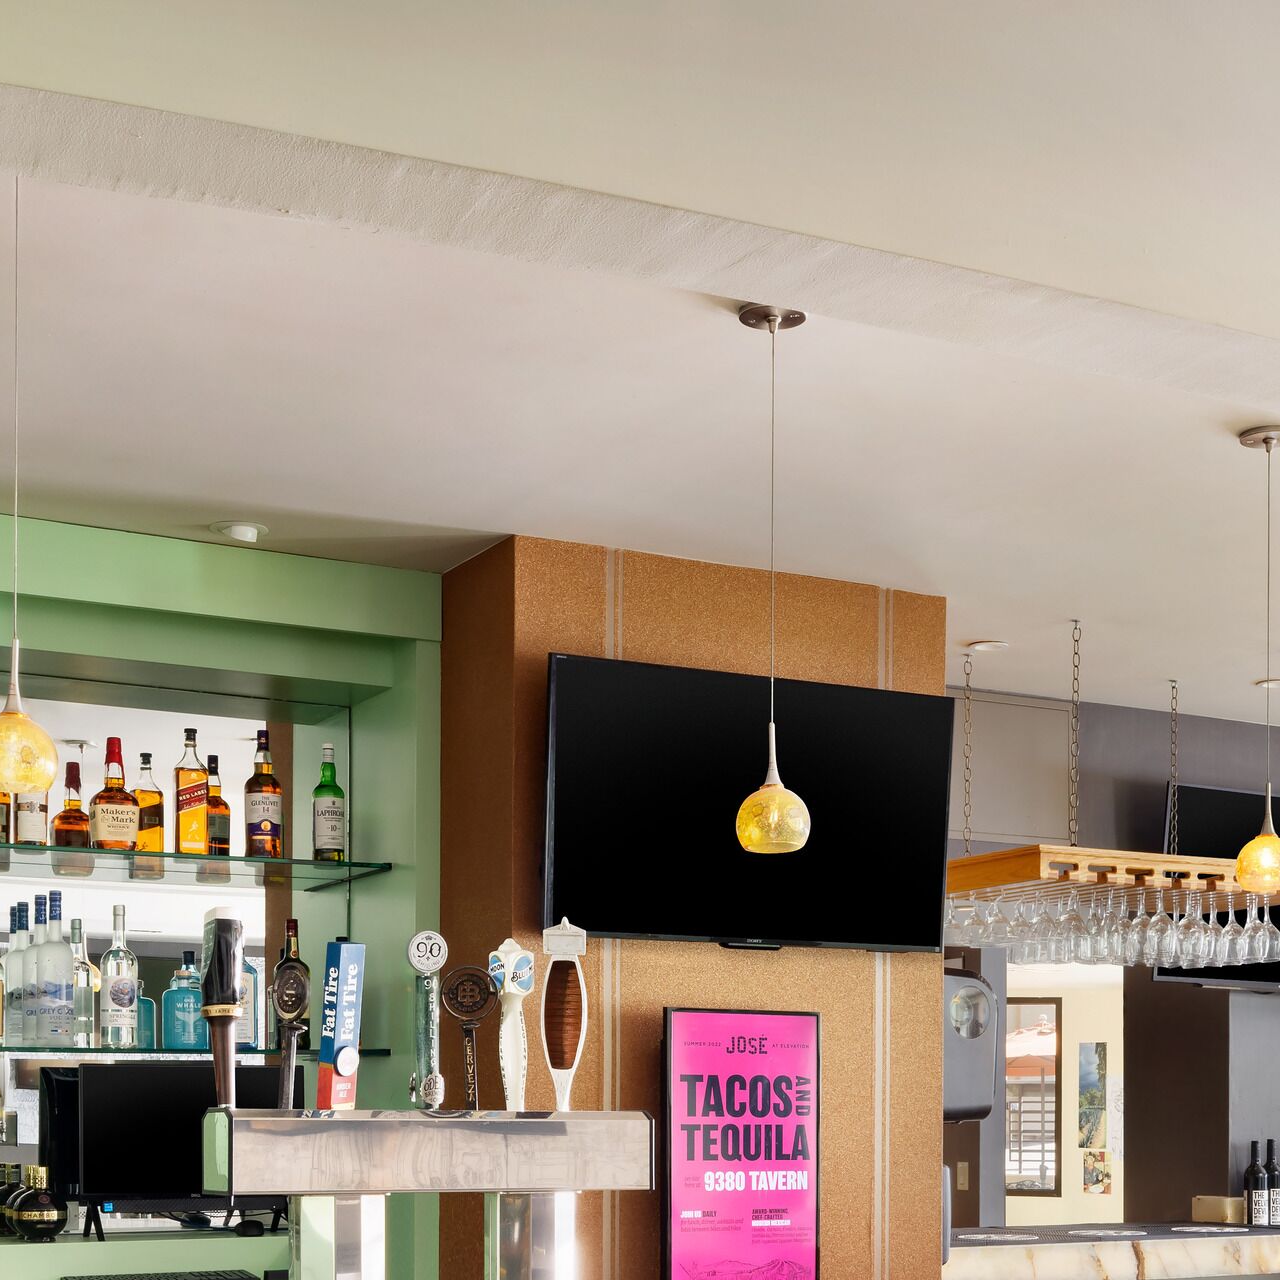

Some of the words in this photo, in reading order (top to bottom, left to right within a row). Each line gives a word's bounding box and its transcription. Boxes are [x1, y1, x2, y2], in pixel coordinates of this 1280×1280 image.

[179, 792, 190, 800] RED
[191, 788, 207, 797] LABEL
[324, 967, 339, 1005] Tire
[342, 963, 358, 1003] Tire
[322, 1006, 335, 1039] Fat
[340, 1008, 355, 1041] Fat
[726, 1034, 768, 1055] JOSÉ
[465, 1038, 475, 1101] CERVEZA
[680, 1074, 792, 1118] TACOS
[795, 1075, 811, 1116] AND
[680, 1123, 810, 1161] TEQUILA
[704, 1171, 745, 1191] 9380
[749, 1171, 808, 1191] TAVERN
[1254, 1191, 1265, 1199] THE
[22, 1211, 57, 1219] CHAMBO
